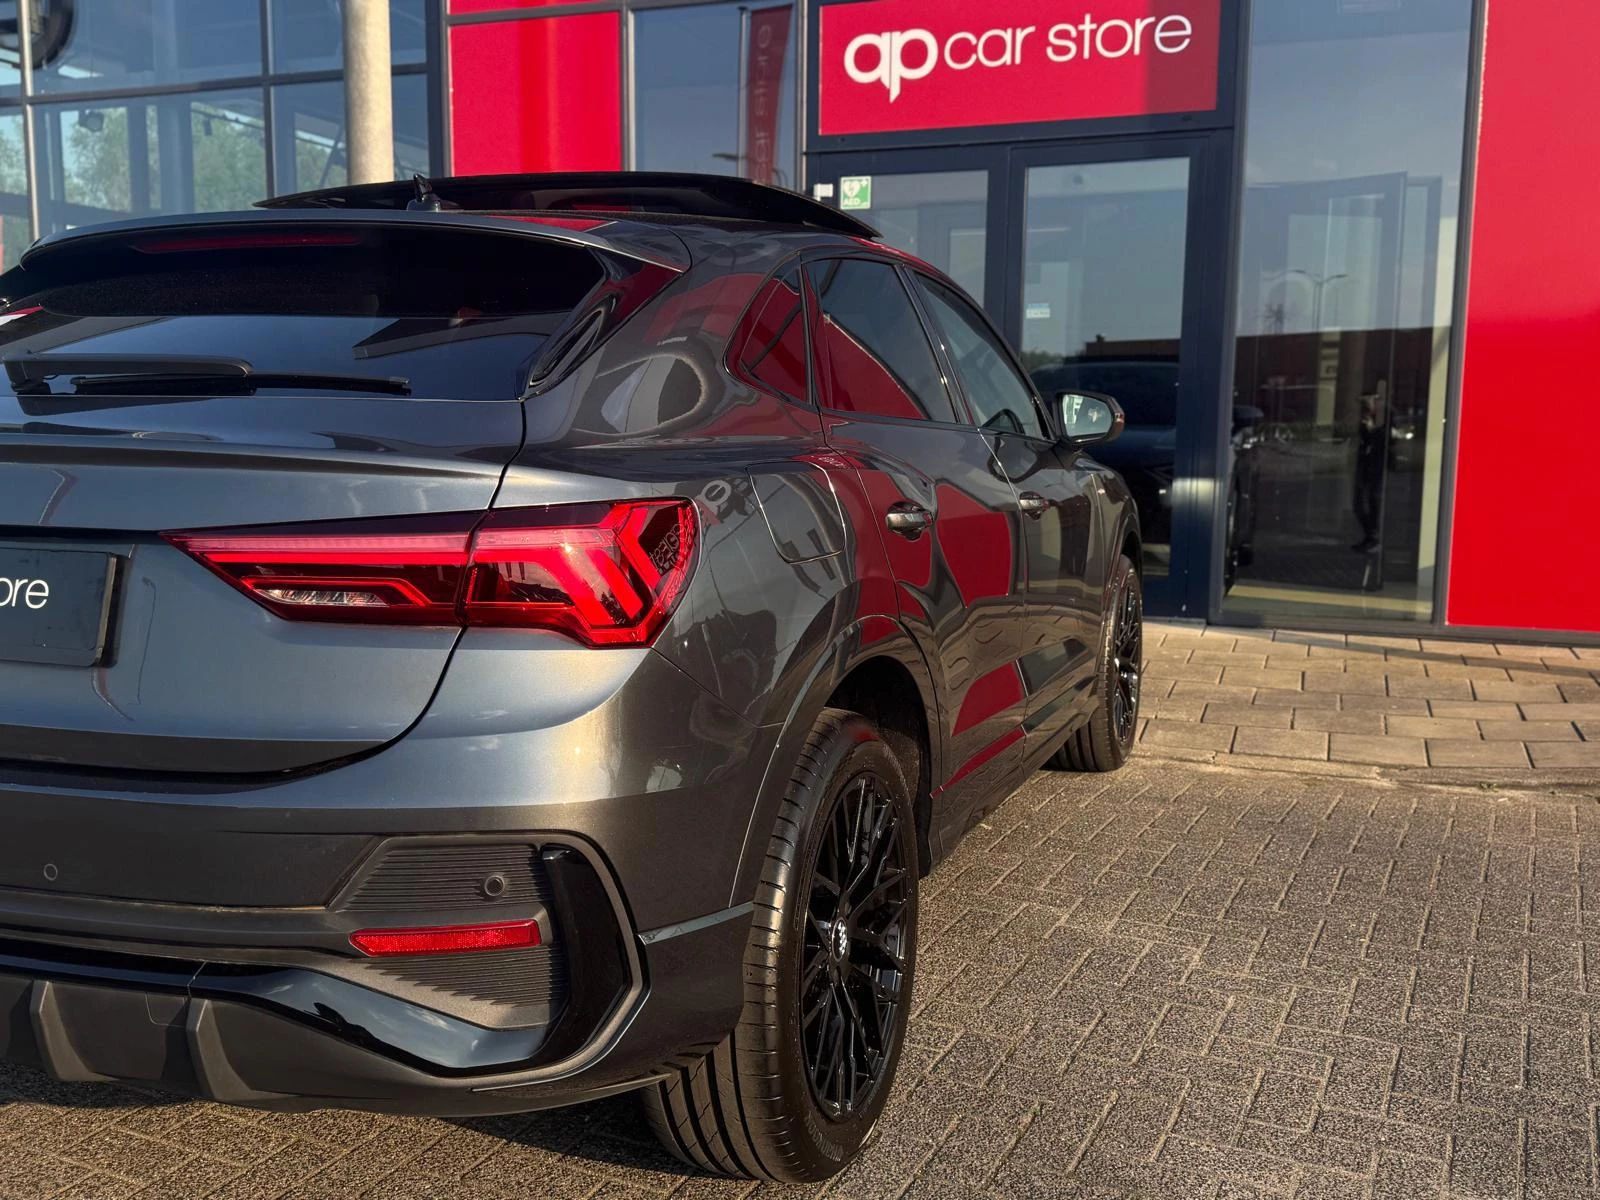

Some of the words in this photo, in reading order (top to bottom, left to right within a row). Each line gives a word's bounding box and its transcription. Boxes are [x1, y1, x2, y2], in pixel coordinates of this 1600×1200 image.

[843, 28, 938, 103] ap
[944, 25, 1035, 70] car
[1046, 13, 1192, 64] store
